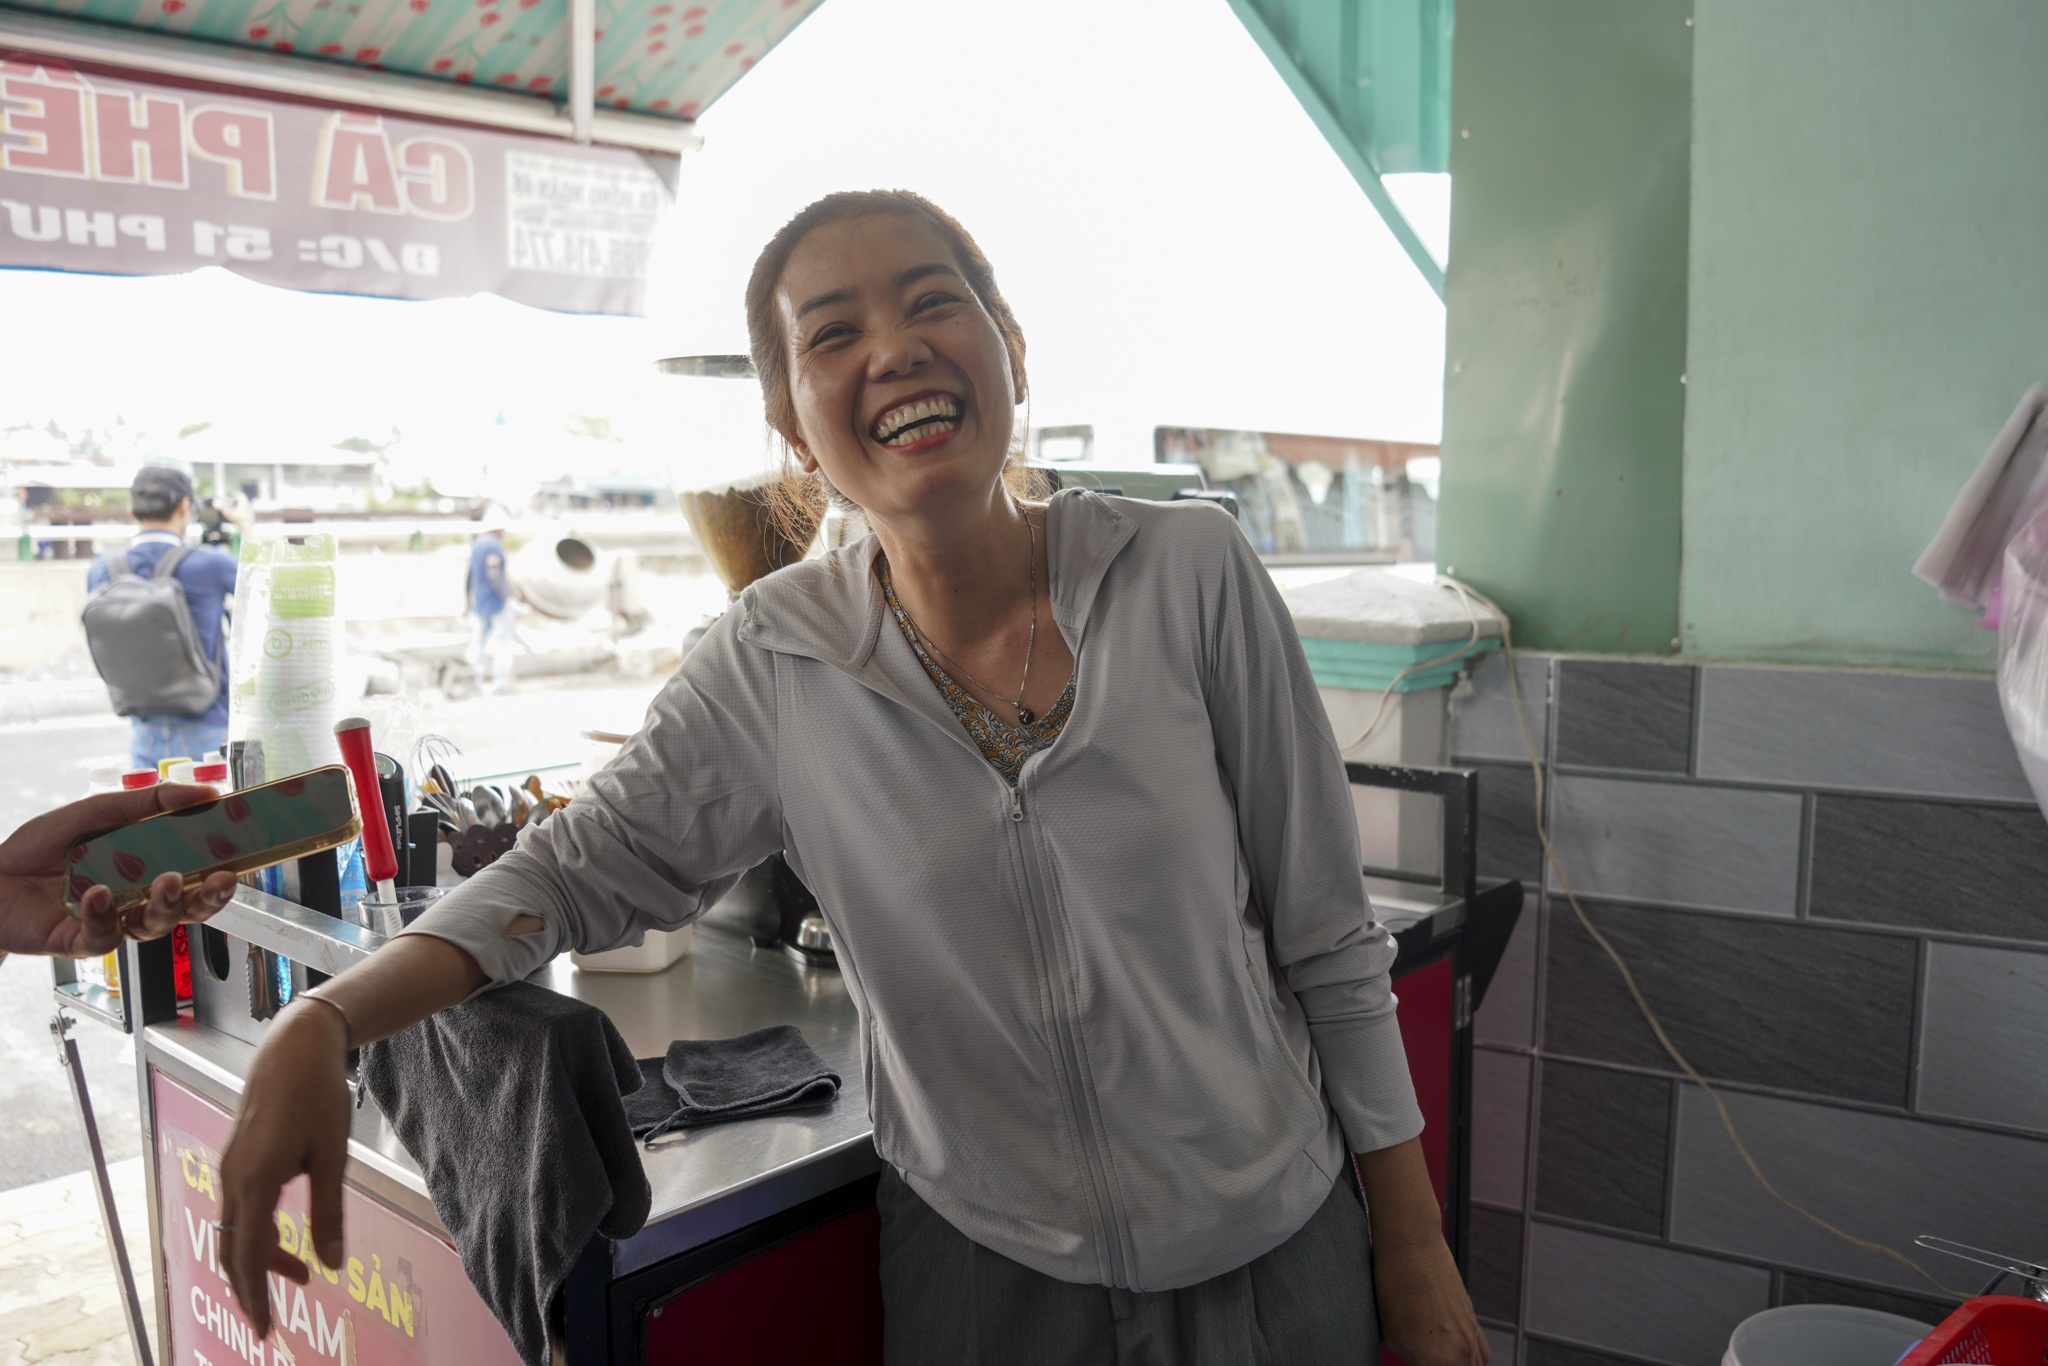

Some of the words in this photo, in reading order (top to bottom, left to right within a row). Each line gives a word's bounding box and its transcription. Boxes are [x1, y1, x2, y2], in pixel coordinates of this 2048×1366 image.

[182, 1147, 215, 1202] CÀ
[277, 1209, 340, 1285] ĐẶ
[347, 1253, 414, 1339] SẢN
[267, 1270, 344, 1366] NAM
